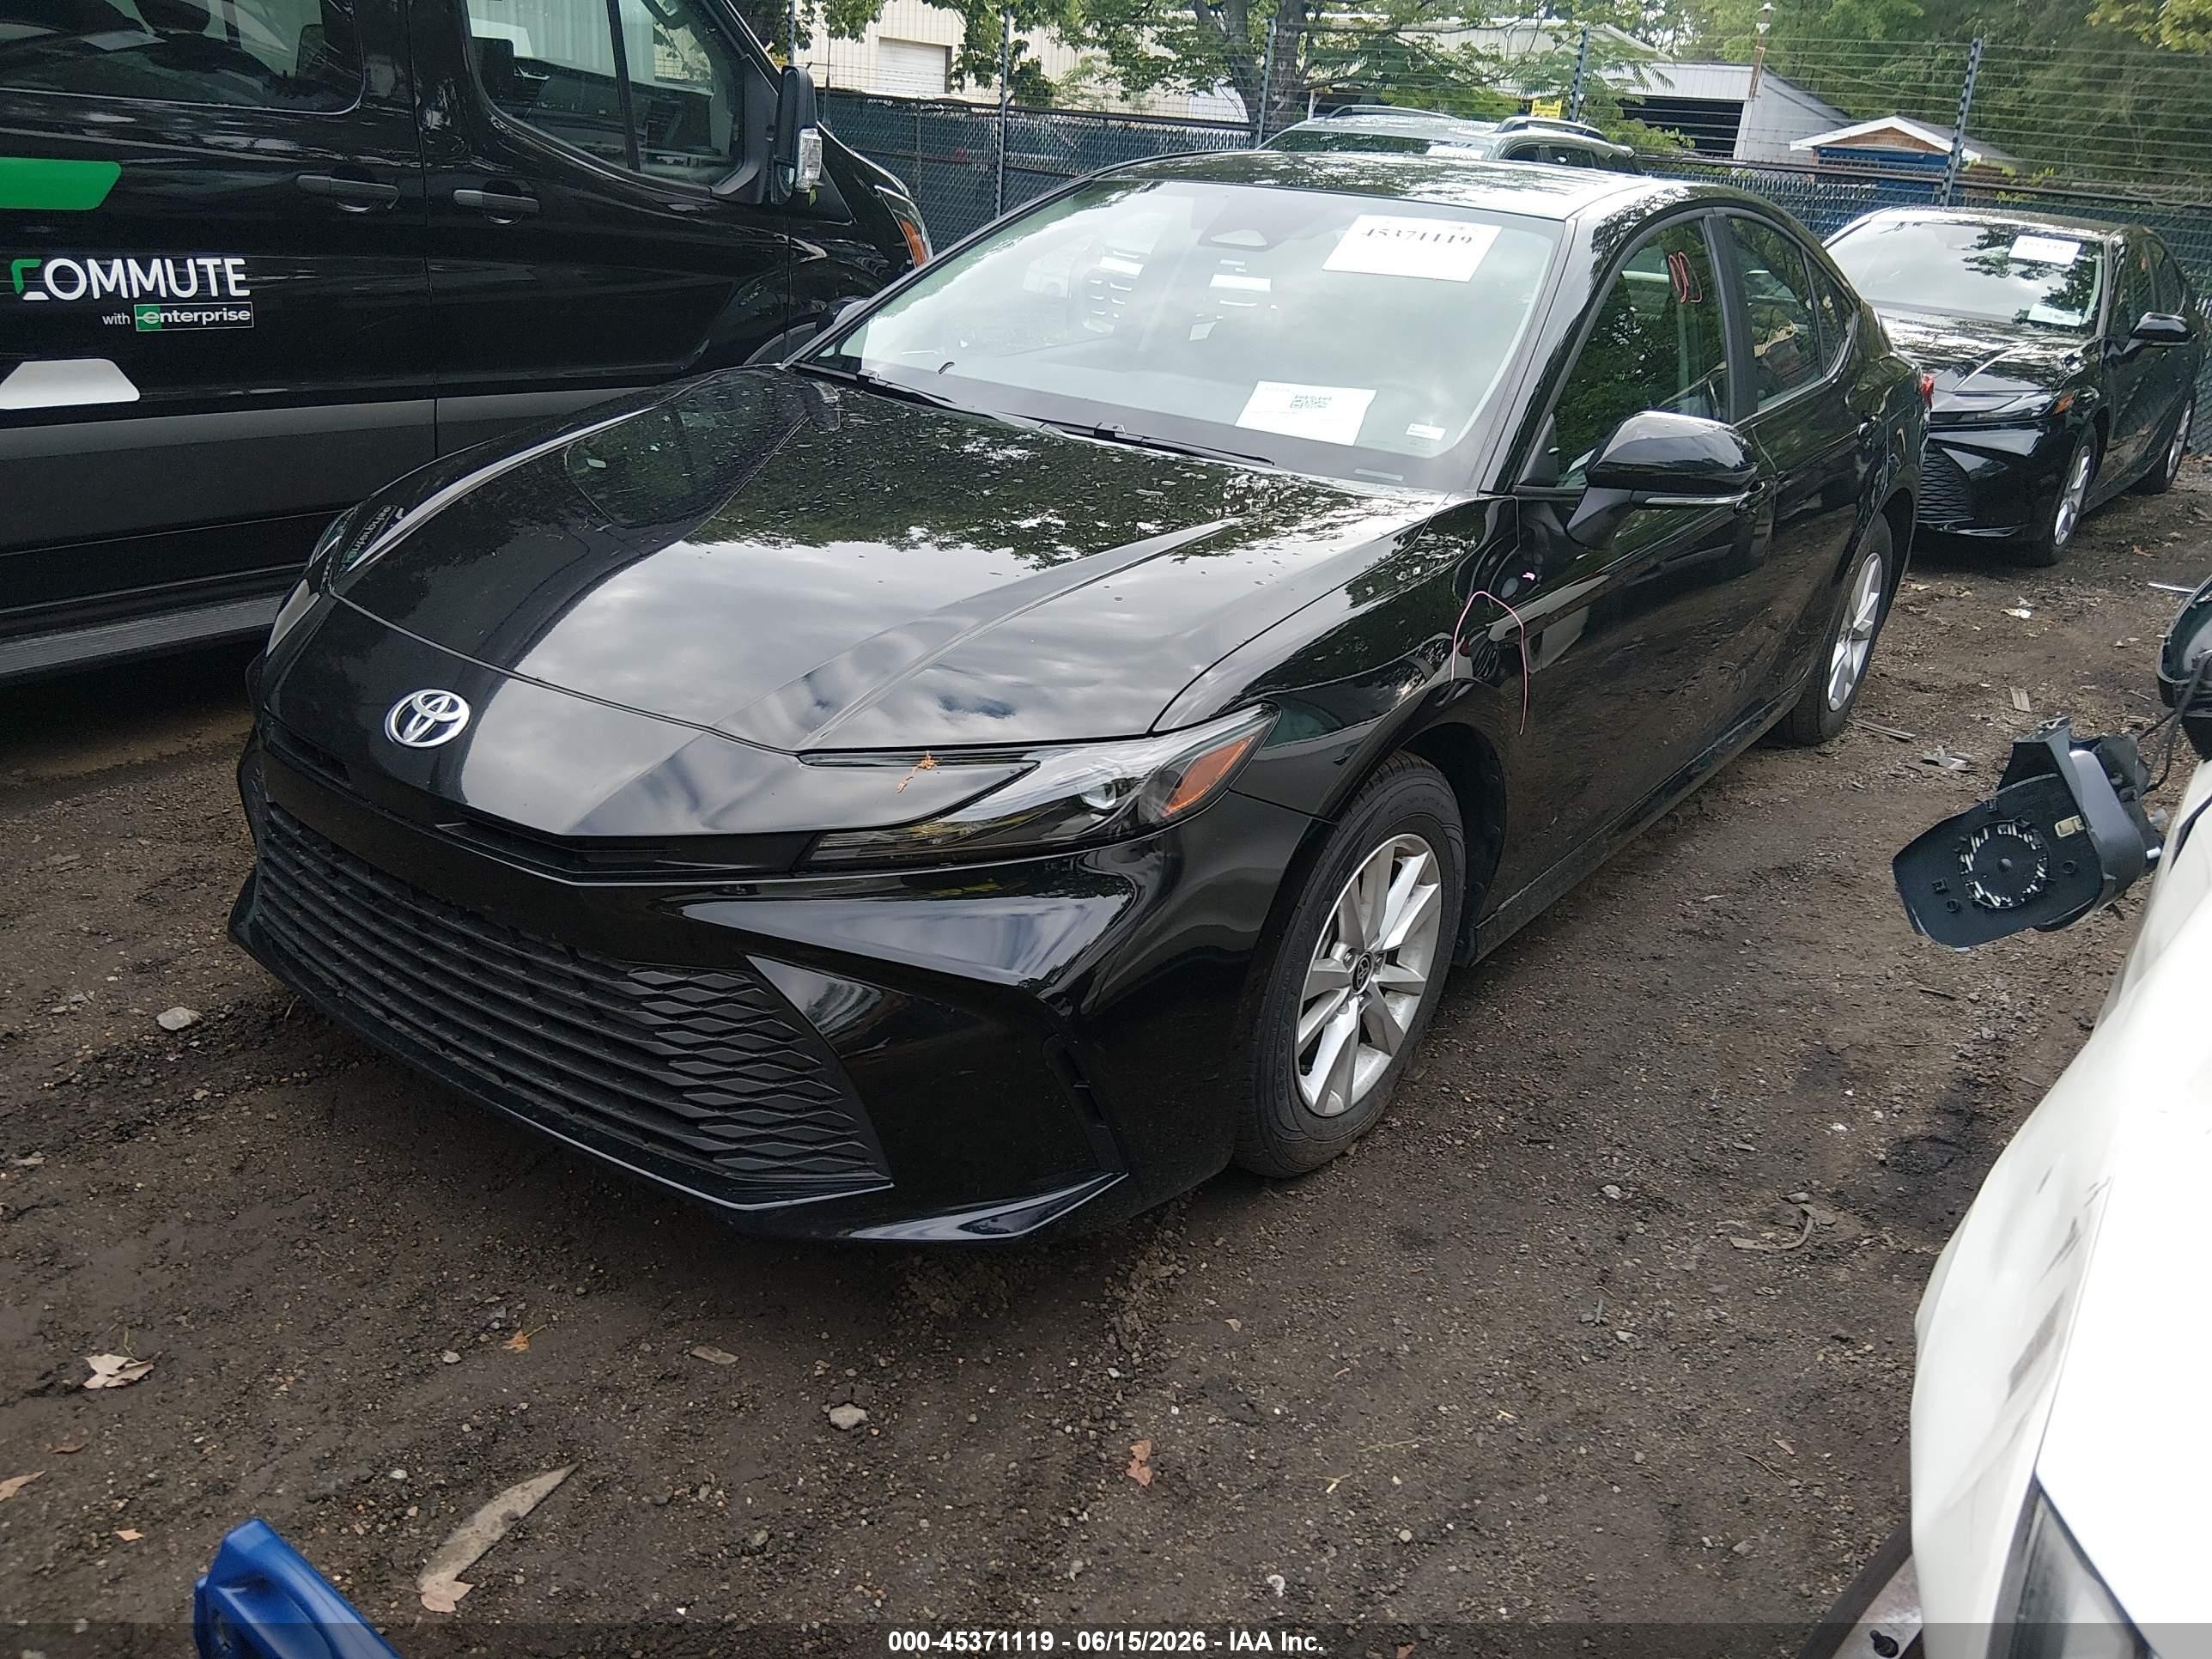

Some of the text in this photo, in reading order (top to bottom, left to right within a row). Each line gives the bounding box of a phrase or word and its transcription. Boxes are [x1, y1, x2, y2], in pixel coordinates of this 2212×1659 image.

[10, 258, 251, 301] COMMUTE
[101, 307, 251, 325] with enterprise
